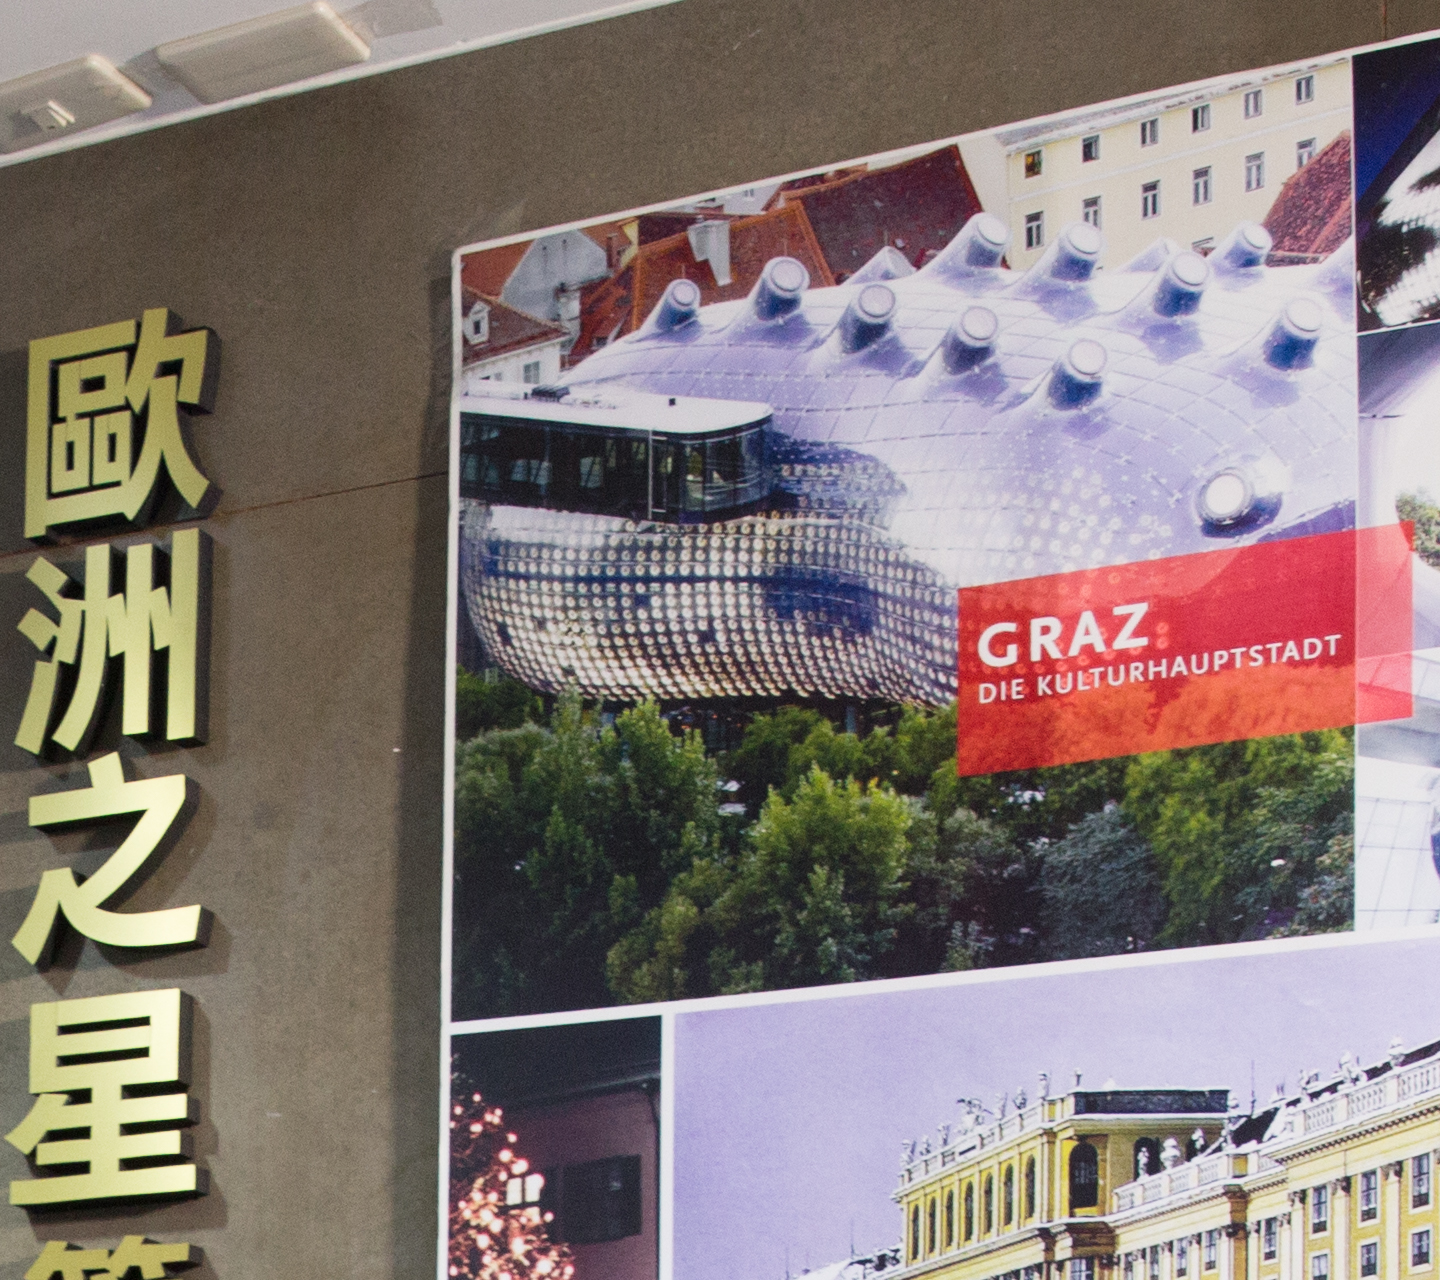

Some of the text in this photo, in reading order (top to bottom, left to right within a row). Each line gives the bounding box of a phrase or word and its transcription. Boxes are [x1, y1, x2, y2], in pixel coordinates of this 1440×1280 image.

[977, 602, 1149, 668] GRAZ
[978, 634, 1343, 704] DIE KULTURHAUPTSTADT
